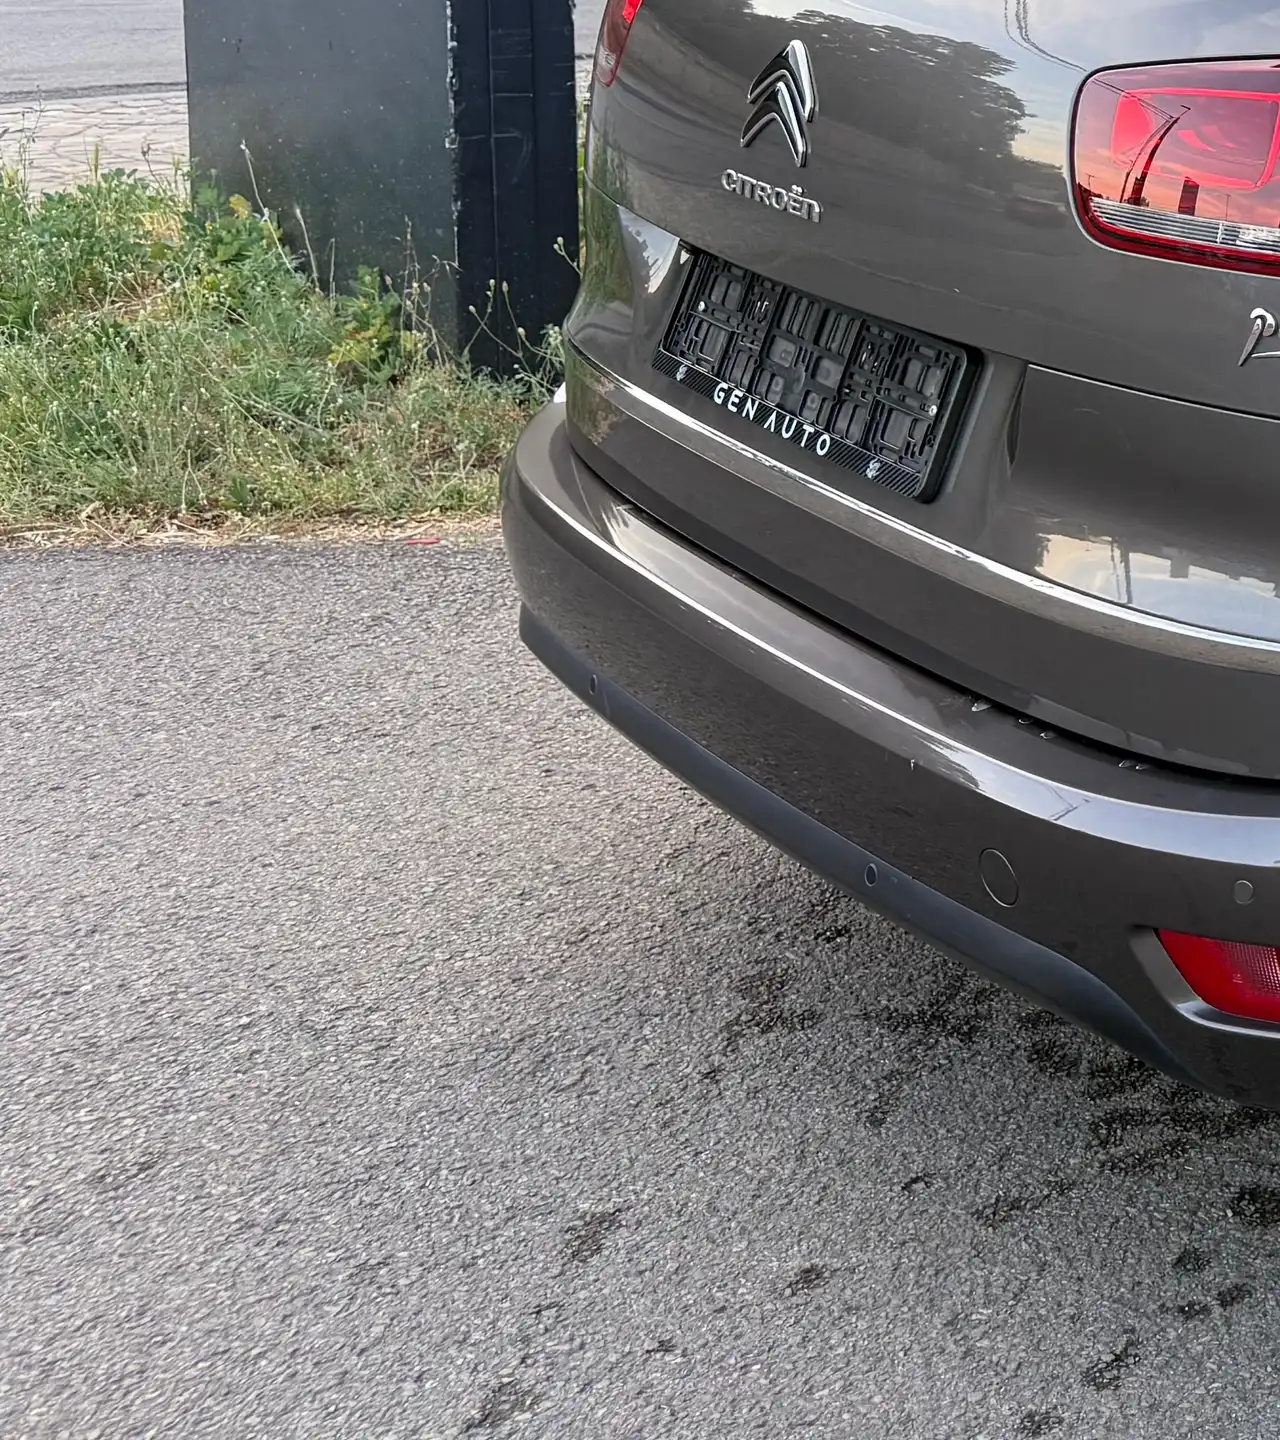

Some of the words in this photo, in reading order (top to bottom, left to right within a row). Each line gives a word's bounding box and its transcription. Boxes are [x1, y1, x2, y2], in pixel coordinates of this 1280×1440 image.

[721, 168, 822, 223] CITROËN
[713, 382, 759, 421] GEN
[763, 413, 831, 456] AUTO
